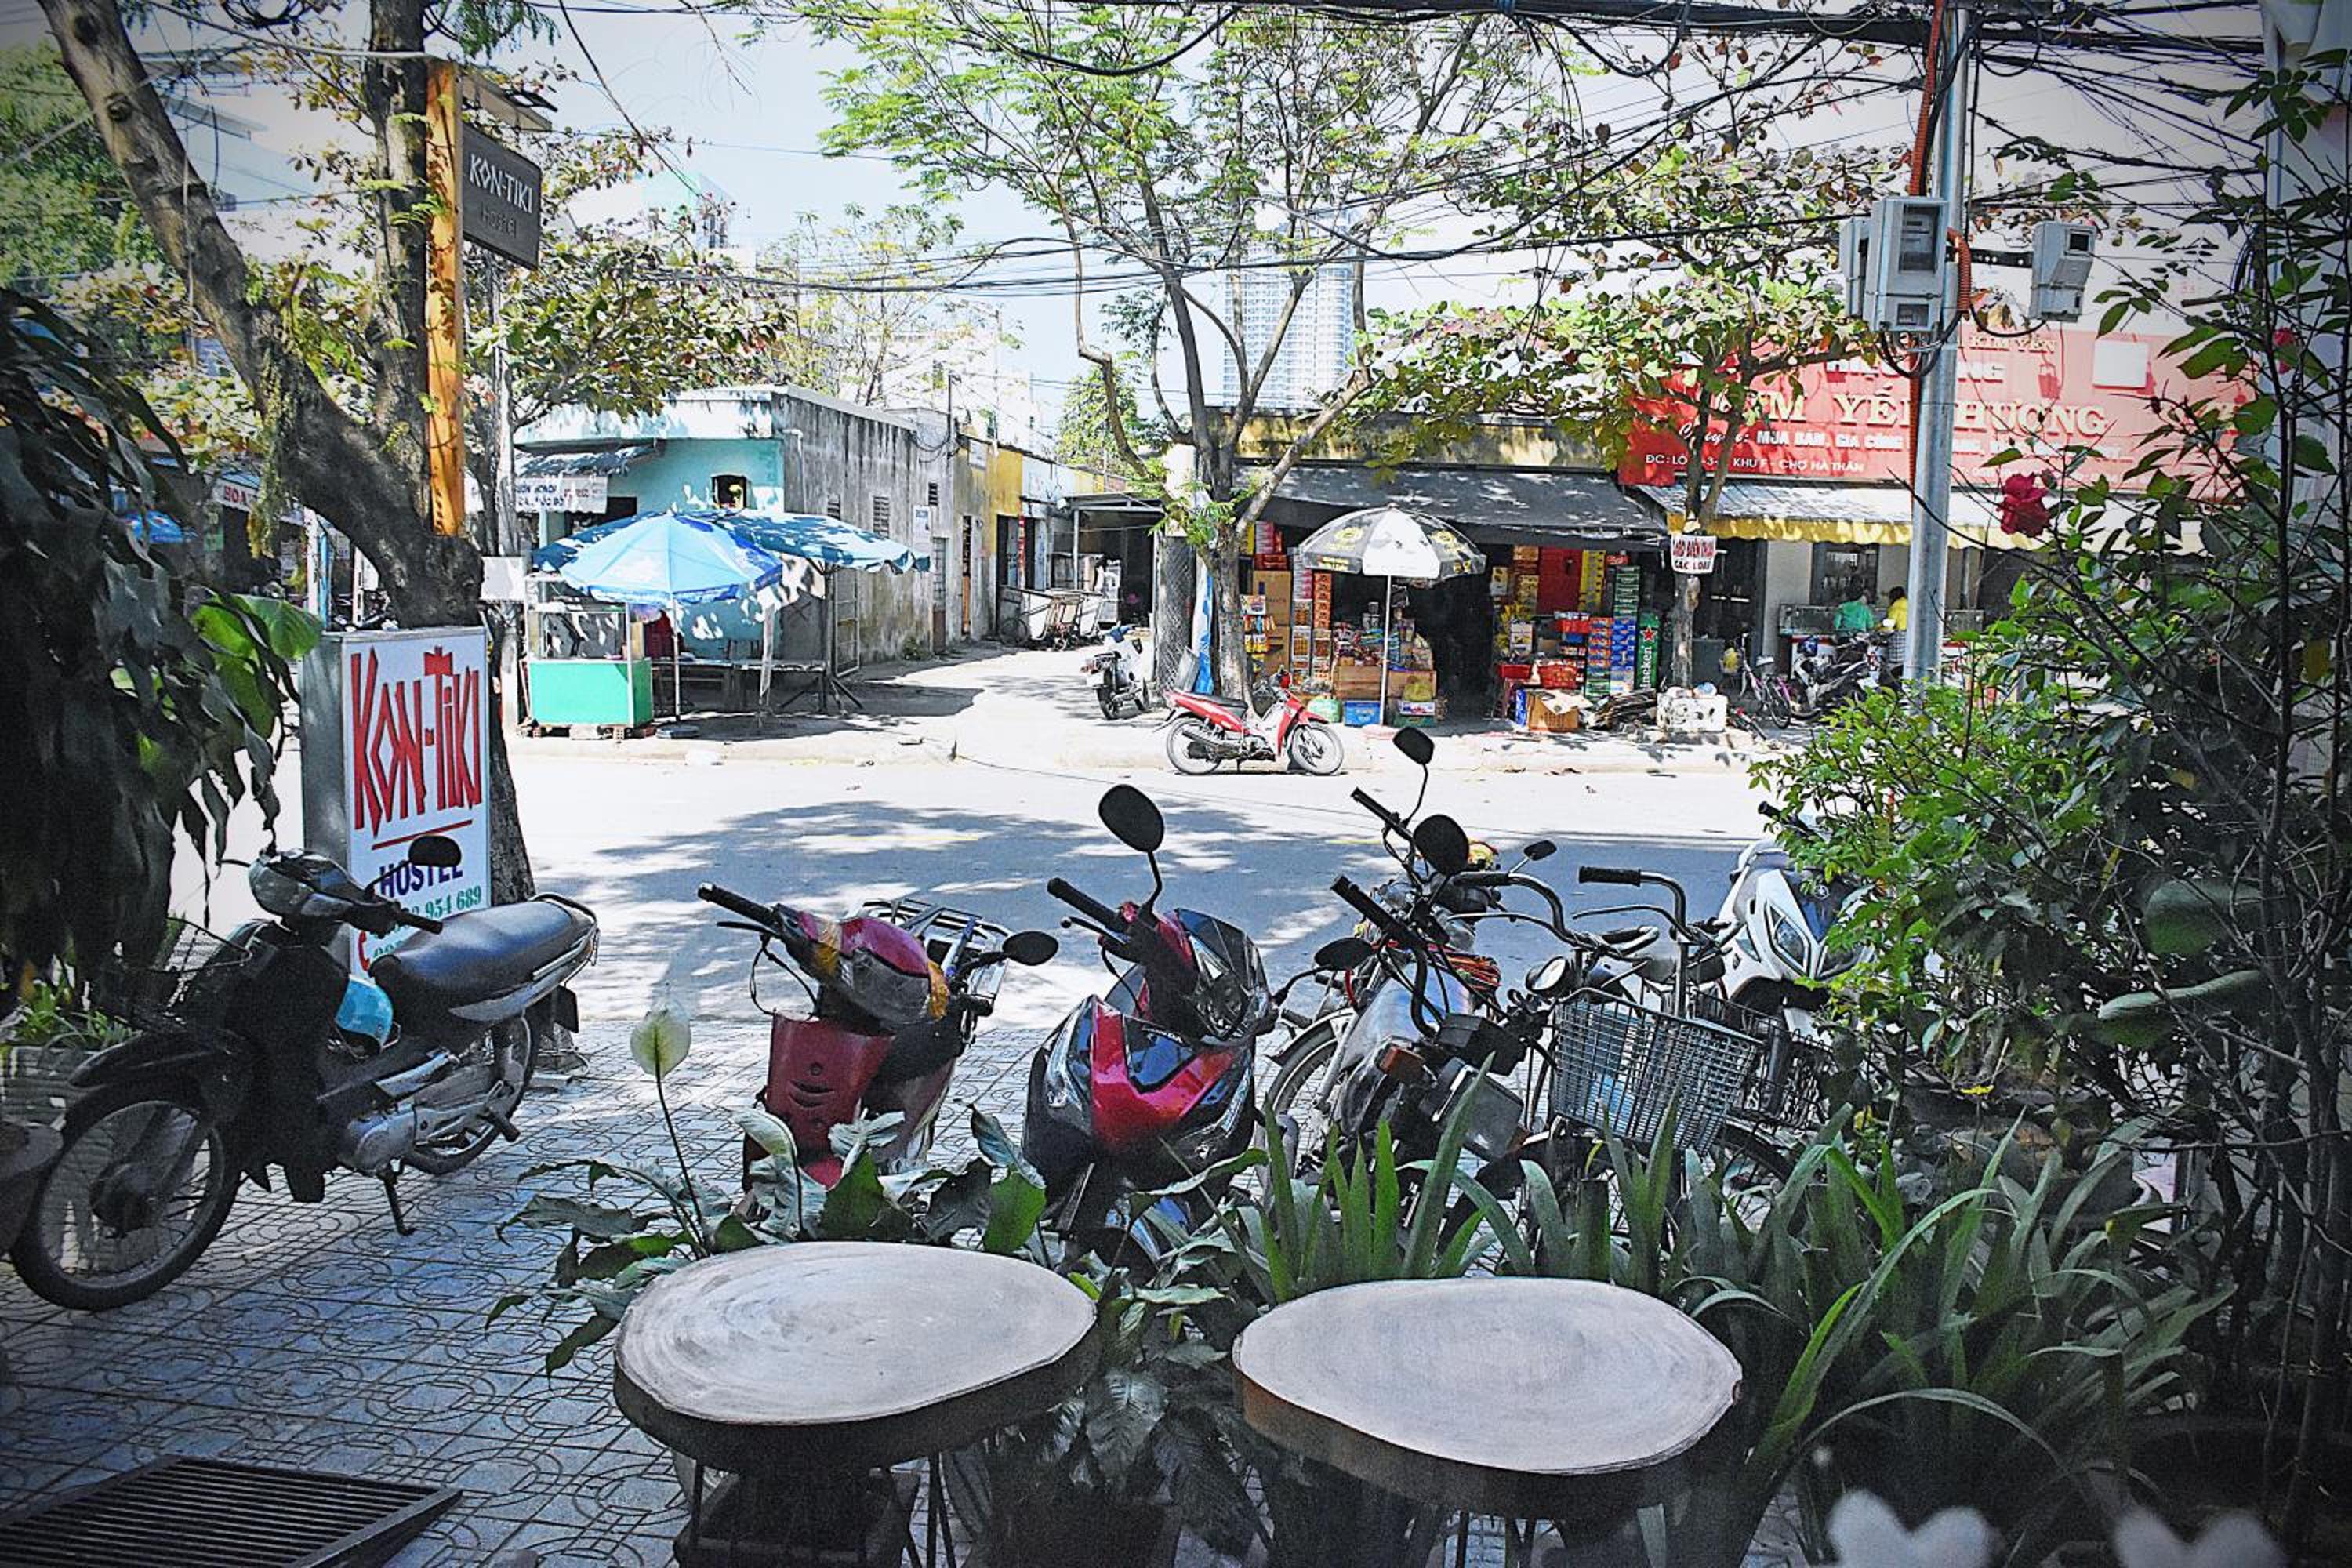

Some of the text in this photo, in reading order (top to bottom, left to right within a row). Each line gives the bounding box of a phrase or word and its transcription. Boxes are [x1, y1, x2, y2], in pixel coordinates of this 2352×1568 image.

[469, 153, 532, 214] KON-TIKI
[1639, 645, 1653, 689] ineken
[456, 885, 482, 911] 689
